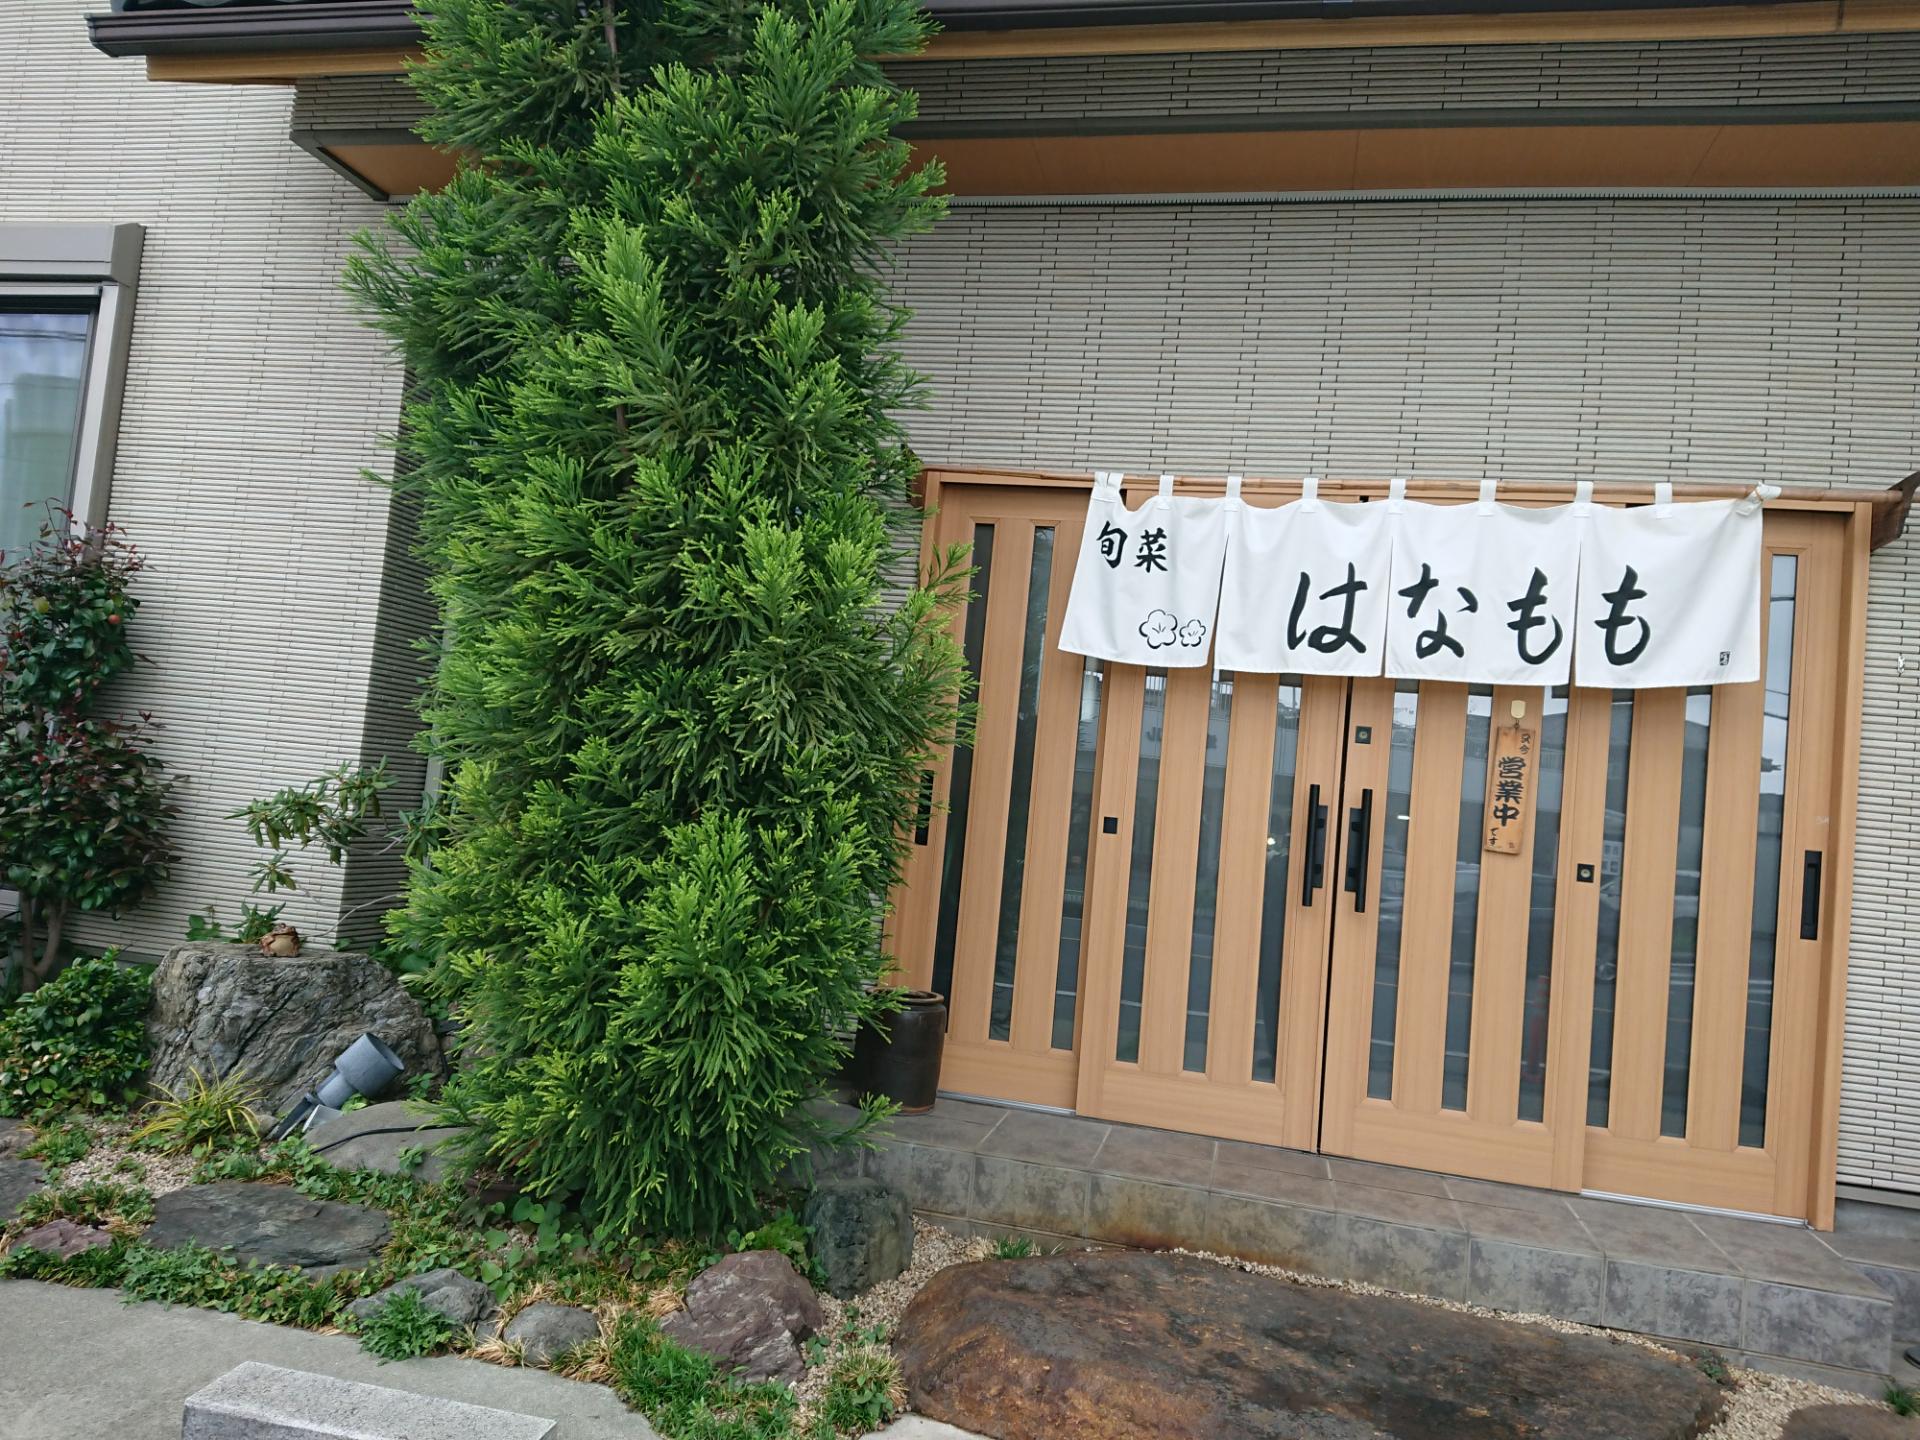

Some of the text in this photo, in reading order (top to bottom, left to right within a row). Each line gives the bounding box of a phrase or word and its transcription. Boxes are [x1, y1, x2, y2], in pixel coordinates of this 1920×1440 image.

[1096, 520, 1168, 573] 旬菜
[1287, 562, 1652, 666] はなもも
[1493, 756, 1526, 827] 営業中
